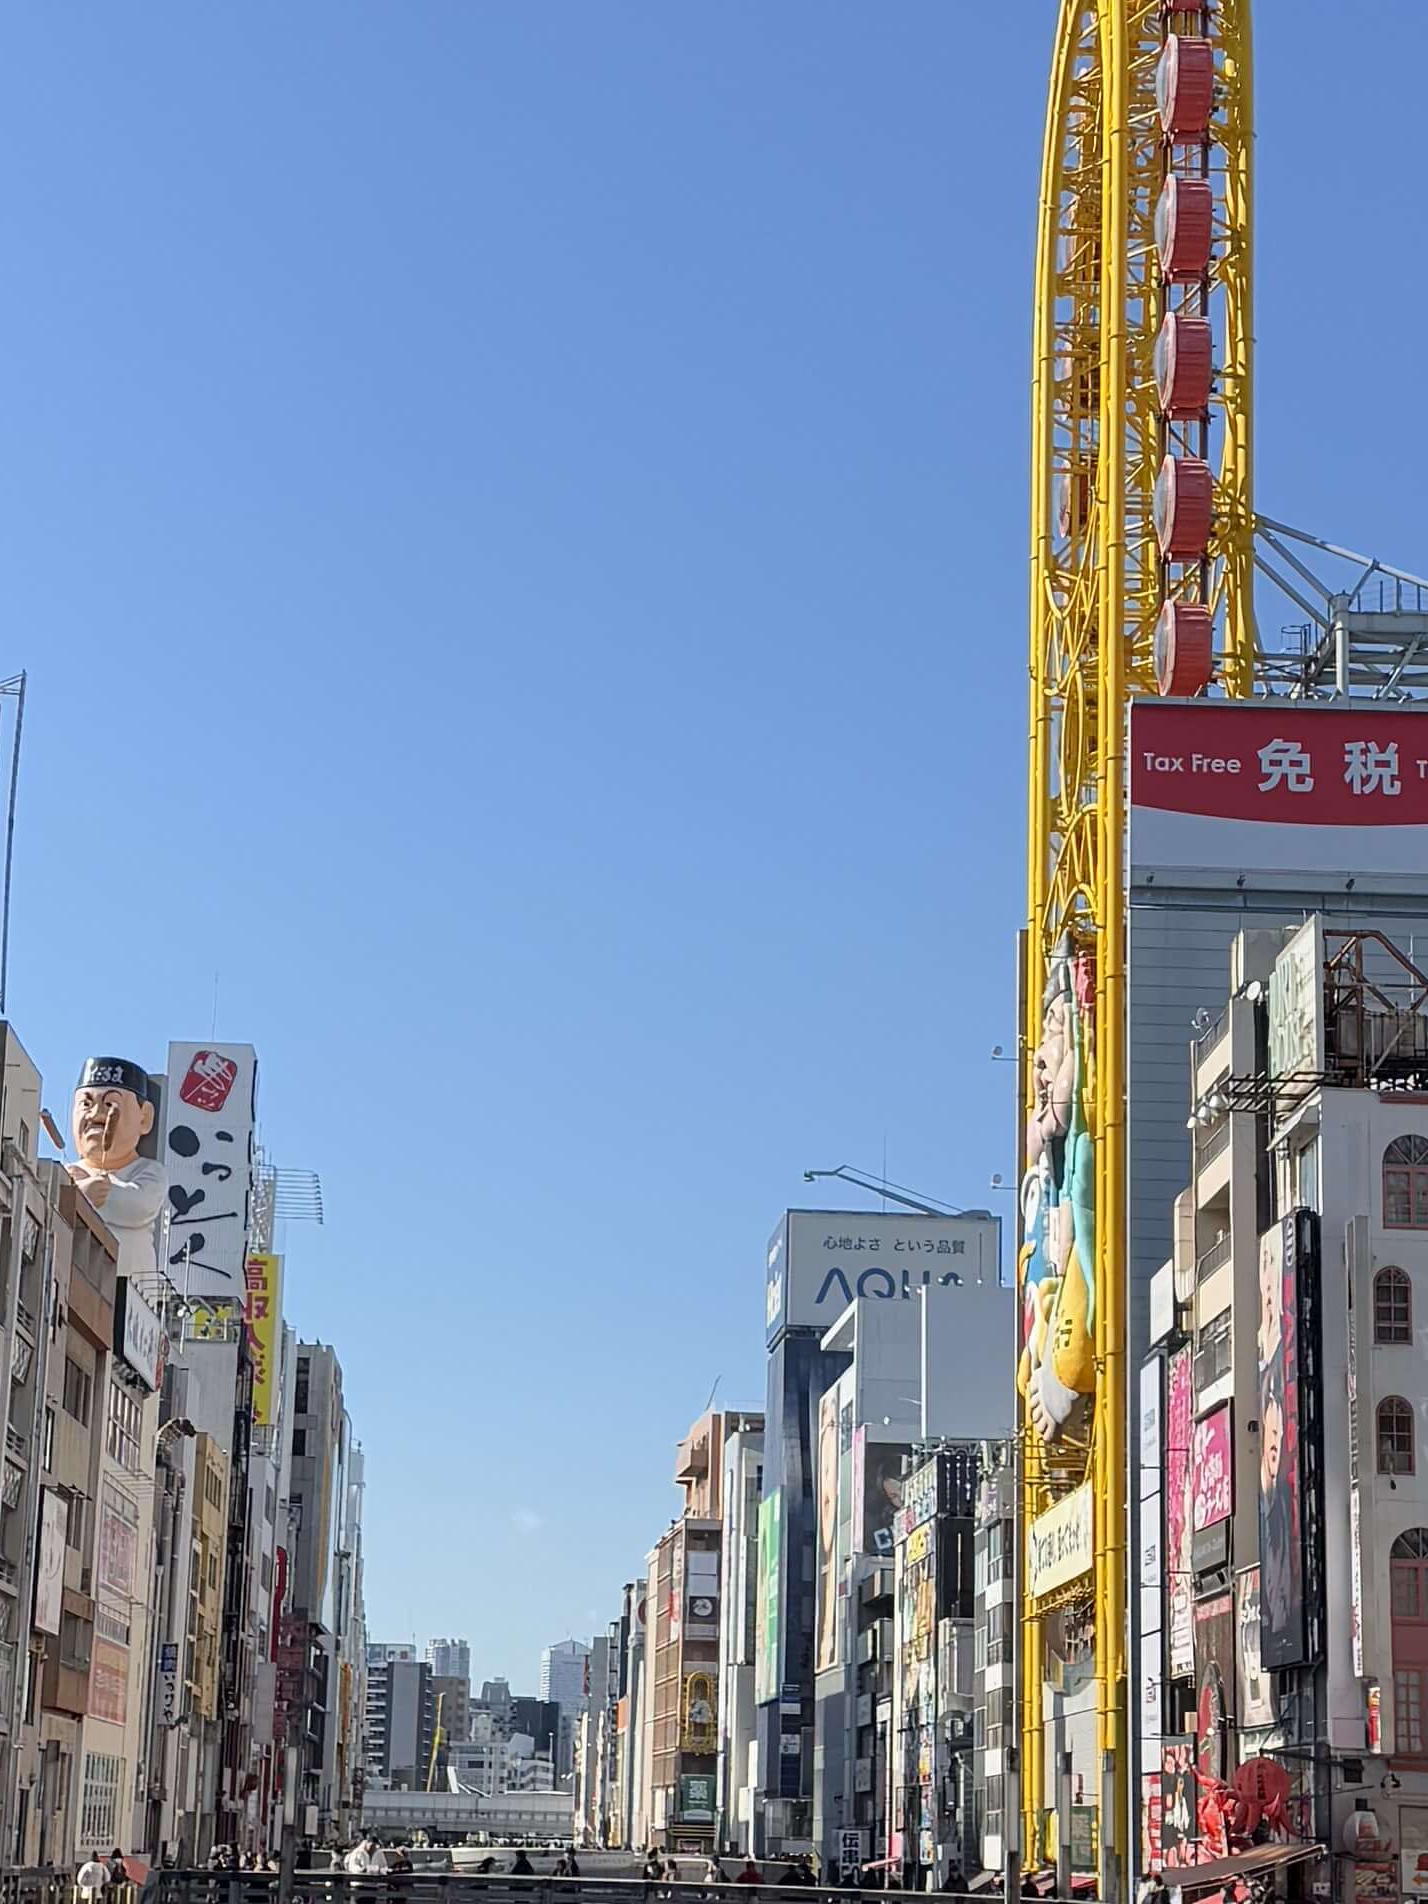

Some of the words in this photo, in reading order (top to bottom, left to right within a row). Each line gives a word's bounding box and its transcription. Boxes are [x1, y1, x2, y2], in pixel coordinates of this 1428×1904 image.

[1144, 751, 1184, 773] Tax
[1192, 752, 1242, 775] Free
[1256, 738, 1401, 796] 免税
[822, 1236, 882, 1252] 心地よさ
[892, 1238, 966, 1255] という品質
